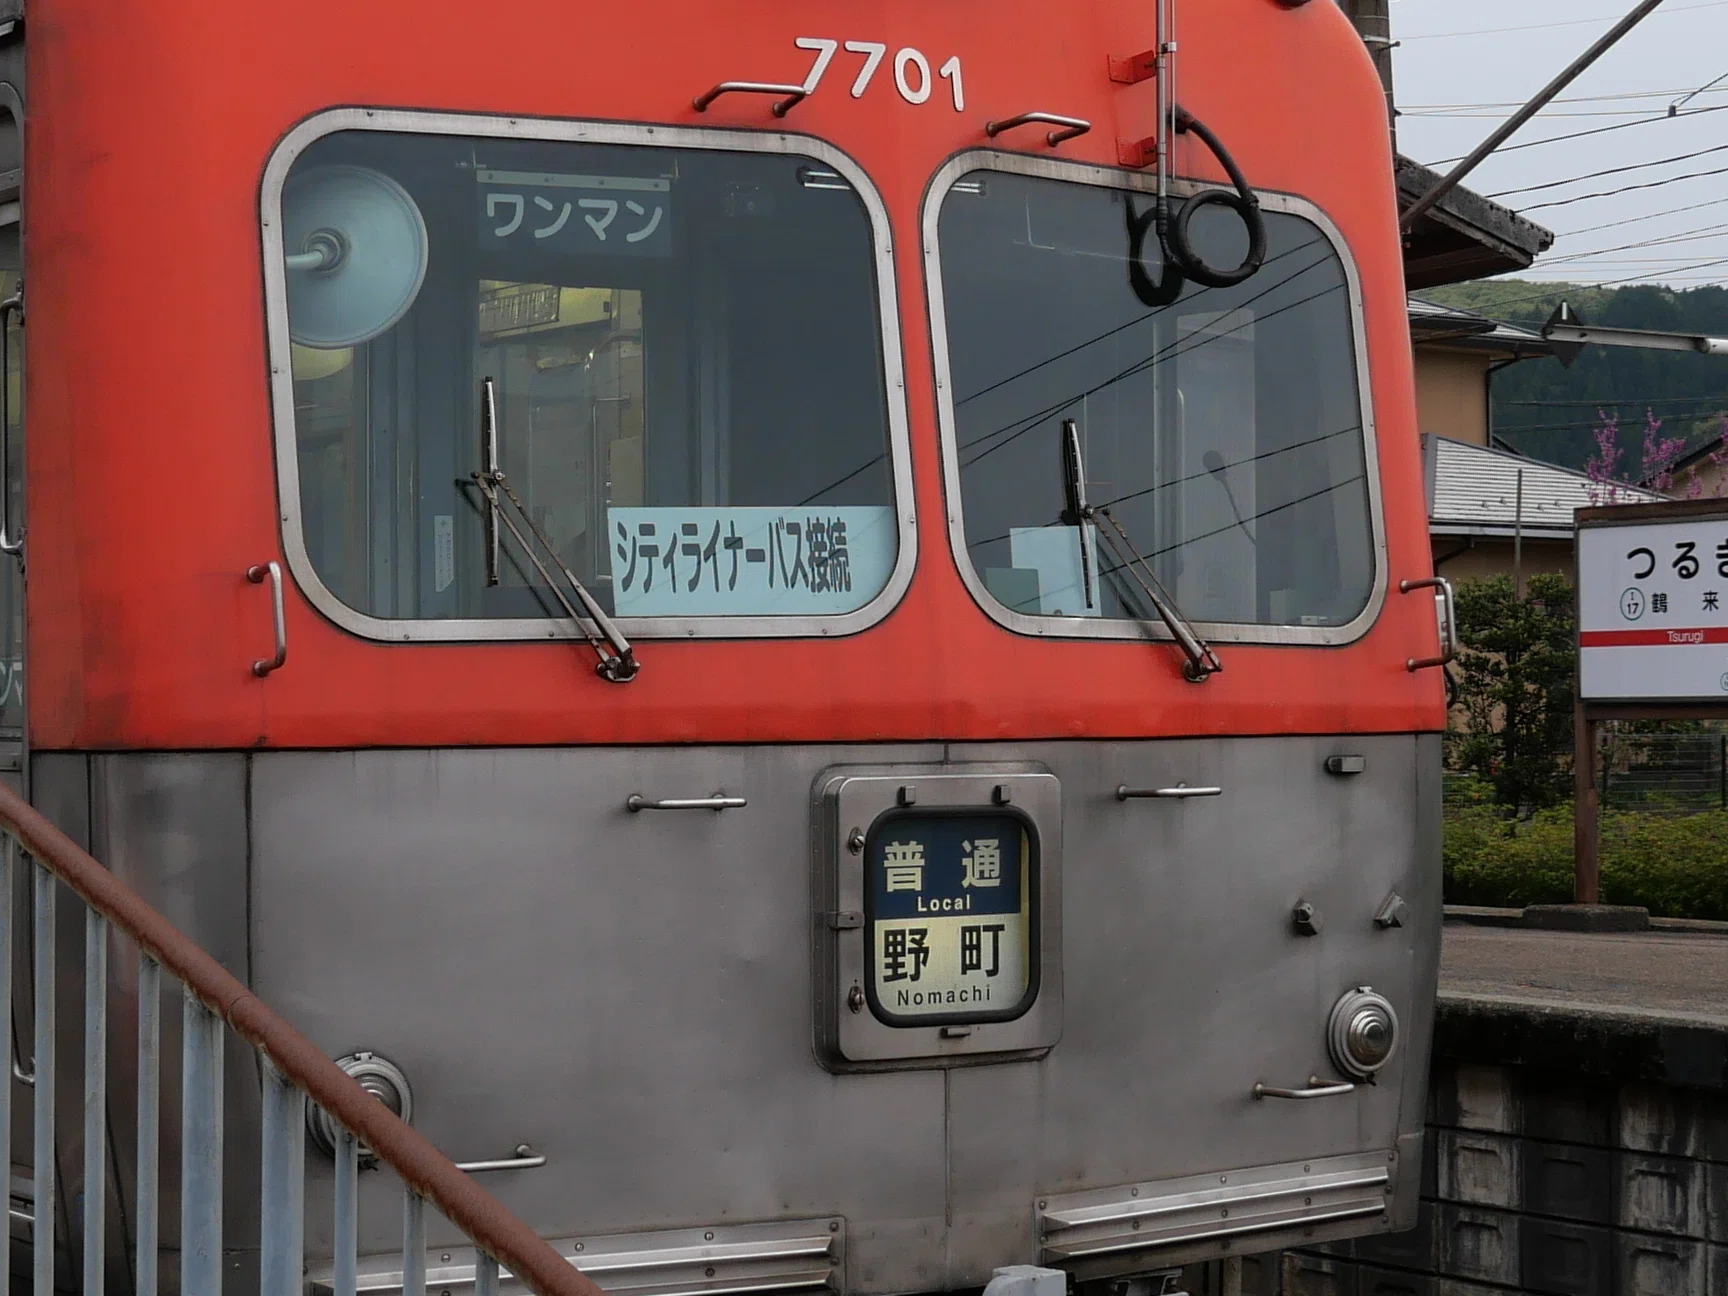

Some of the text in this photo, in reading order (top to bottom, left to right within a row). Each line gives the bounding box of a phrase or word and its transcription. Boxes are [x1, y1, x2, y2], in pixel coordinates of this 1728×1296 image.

[795, 37, 966, 113] 7701
[484, 191, 663, 243] ワンマン
[617, 516, 852, 594] シティライナーバス接続
[1626, 602, 1640, 615] 17
[1667, 630, 1704, 643] Tsurugi
[883, 838, 1002, 893] 普通
[917, 894, 971, 913] Local
[883, 924, 1005, 983] 野町
[897, 984, 992, 1006] Nomachi
